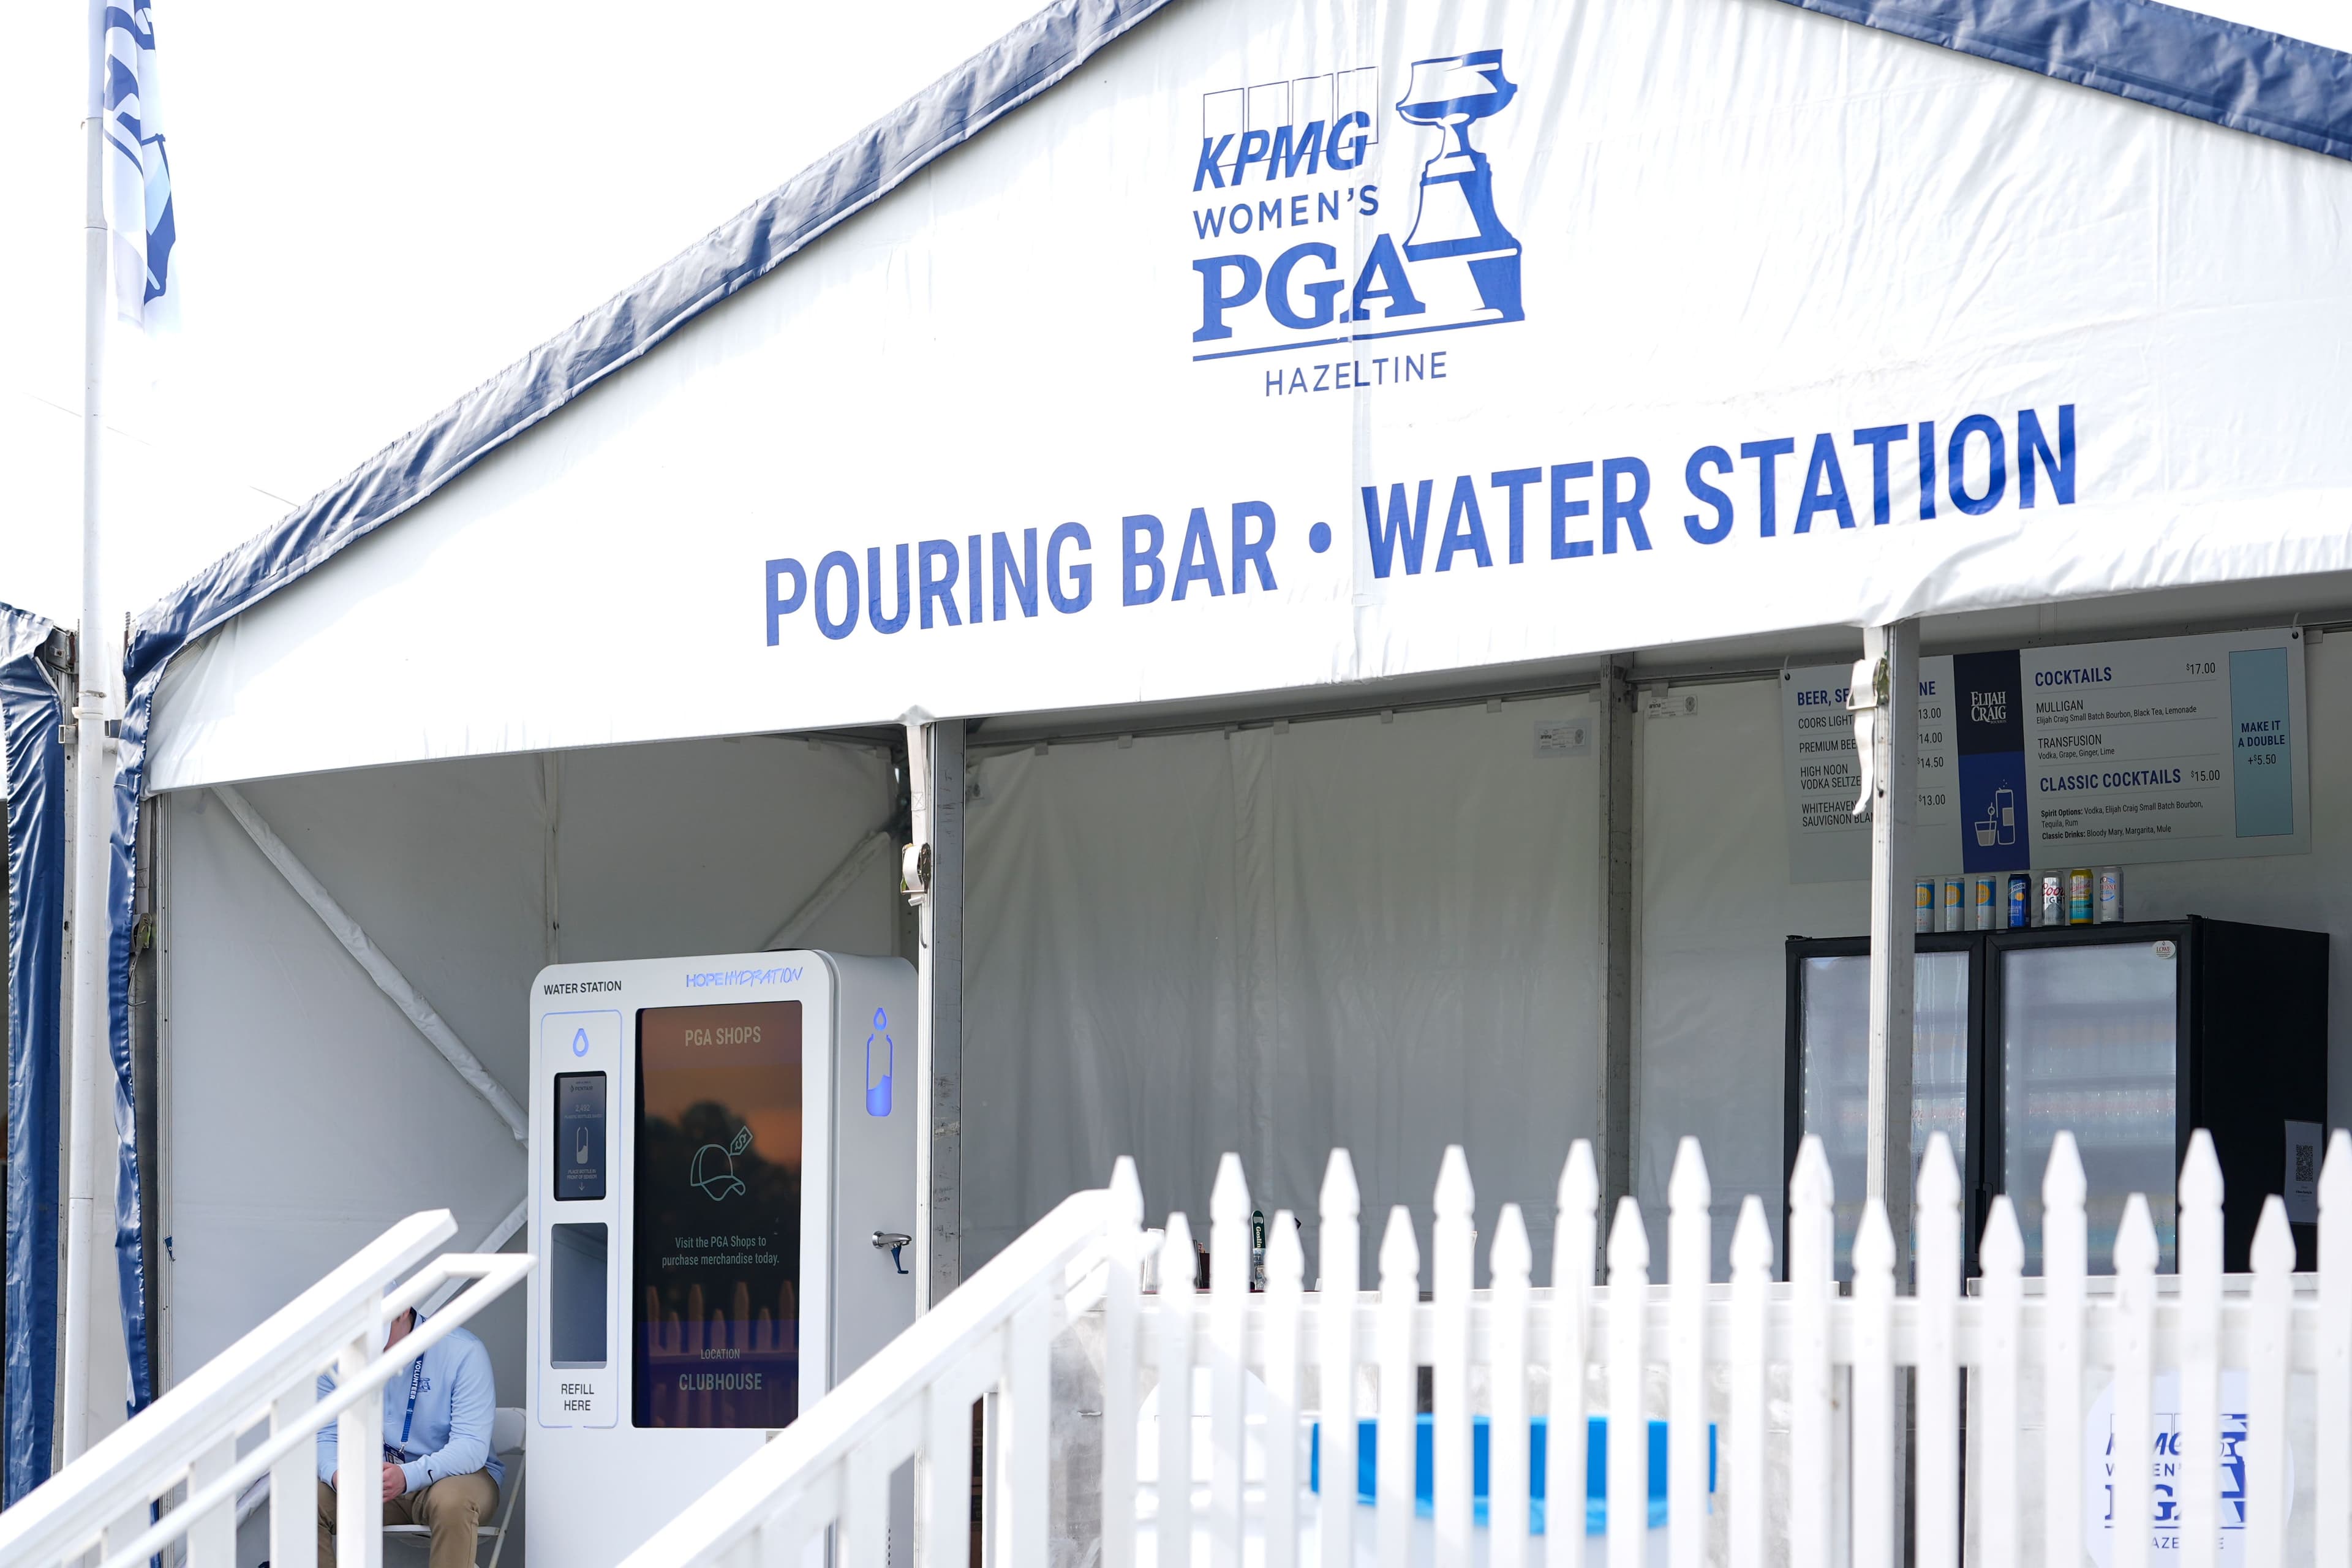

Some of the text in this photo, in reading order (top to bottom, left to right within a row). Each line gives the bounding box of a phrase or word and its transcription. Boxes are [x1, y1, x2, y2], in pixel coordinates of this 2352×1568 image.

[1193, 111, 1371, 192] KPMG
[1193, 184, 1379, 239] WOMEN'S
[1193, 233, 1426, 342] PGA
[1266, 351, 1447, 397] HAZELTINE
[766, 403, 2076, 647] POURING BAR WATER STATION
[2035, 662, 2216, 687] COCKTAILS $17.00
[1797, 690, 1831, 706] BEER,
[1970, 692, 2007, 708] ELIJAH
[1971, 706, 2007, 722] CRAIG
[2037, 699, 2084, 714] MULLIGAN
[1798, 707, 1941, 729] COORS LIGHT 13.00
[2037, 705, 2197, 726] Elijah Craig Small Batch Bourbon, Black Tea, Lemonade
[2241, 720, 2281, 733] MAKE IT
[1800, 740, 1839, 753] PREMIUM
[1841, 739, 1857, 750] BEE
[2038, 734, 2102, 748] TRANSFUSION
[2238, 734, 2285, 747] A DOUBLE
[2079, 749, 2100, 758] Ginger,
[2248, 753, 2277, 765] +$5.50
[1801, 766, 1821, 777] HIGH
[1823, 764, 1849, 776] NOON
[1801, 775, 1861, 790] VODKA SELTZE
[2040, 768, 2220, 792] CLASSIC COCKTAILS $15.00
[1802, 794, 1946, 814] WHITEHAVEN $13.00
[2041, 800, 2204, 819] Spirit Options: Vodka, Elijah Craig Small Batch Bourbon,
[1803, 813, 1852, 827] SAUVIGNON
[2041, 820, 2064, 829] Tequila,
[2065, 830, 2086, 839] Drinks:
[2087, 829, 2107, 839] Bloody
[2108, 828, 2124, 837] Mary,
[2125, 826, 2155, 836] Margarita,
[2157, 824, 2172, 833] Mule
[543, 981, 622, 995] WATER STATION
[685, 1026, 761, 1047] PGA SHOPS
[675, 1235, 767, 1250] Visit the PGA Shops to
[662, 1252, 780, 1268] purchase merchandise today.
[700, 1348, 741, 1360] LOCATION
[409, 1360, 423, 1400] VOLUNTEER
[679, 1372, 763, 1391] CLUBHOUSE
[561, 1383, 595, 1395] REFILL
[564, 1400, 592, 1411] HERE
